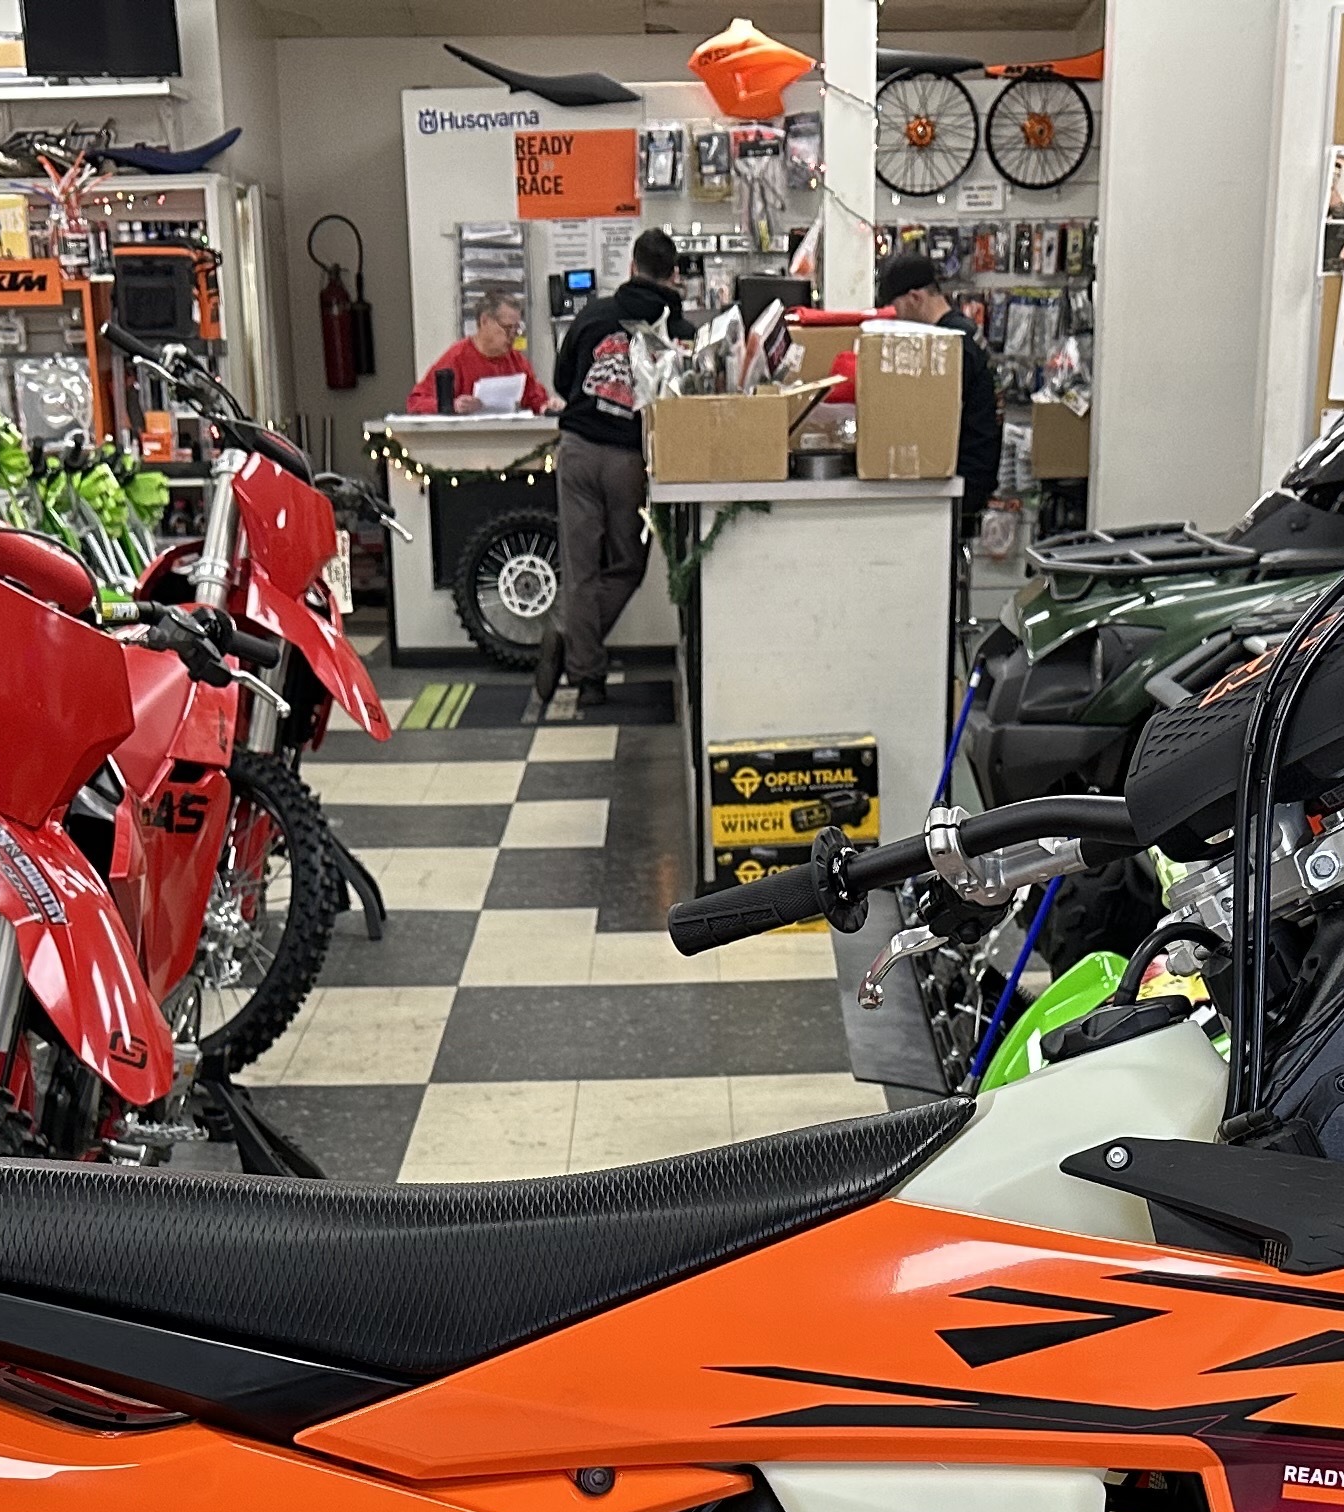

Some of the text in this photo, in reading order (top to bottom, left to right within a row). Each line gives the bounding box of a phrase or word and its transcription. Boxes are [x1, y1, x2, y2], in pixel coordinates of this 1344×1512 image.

[440, 110, 540, 131] Husqvarna
[515, 136, 574, 155] READY
[517, 157, 539, 175] TO
[517, 176, 564, 195] RACE
[764, 767, 859, 787] OPEN TRAIL
[721, 818, 785, 833] WINCH
[13, 854, 68, 924] COUNTRY
